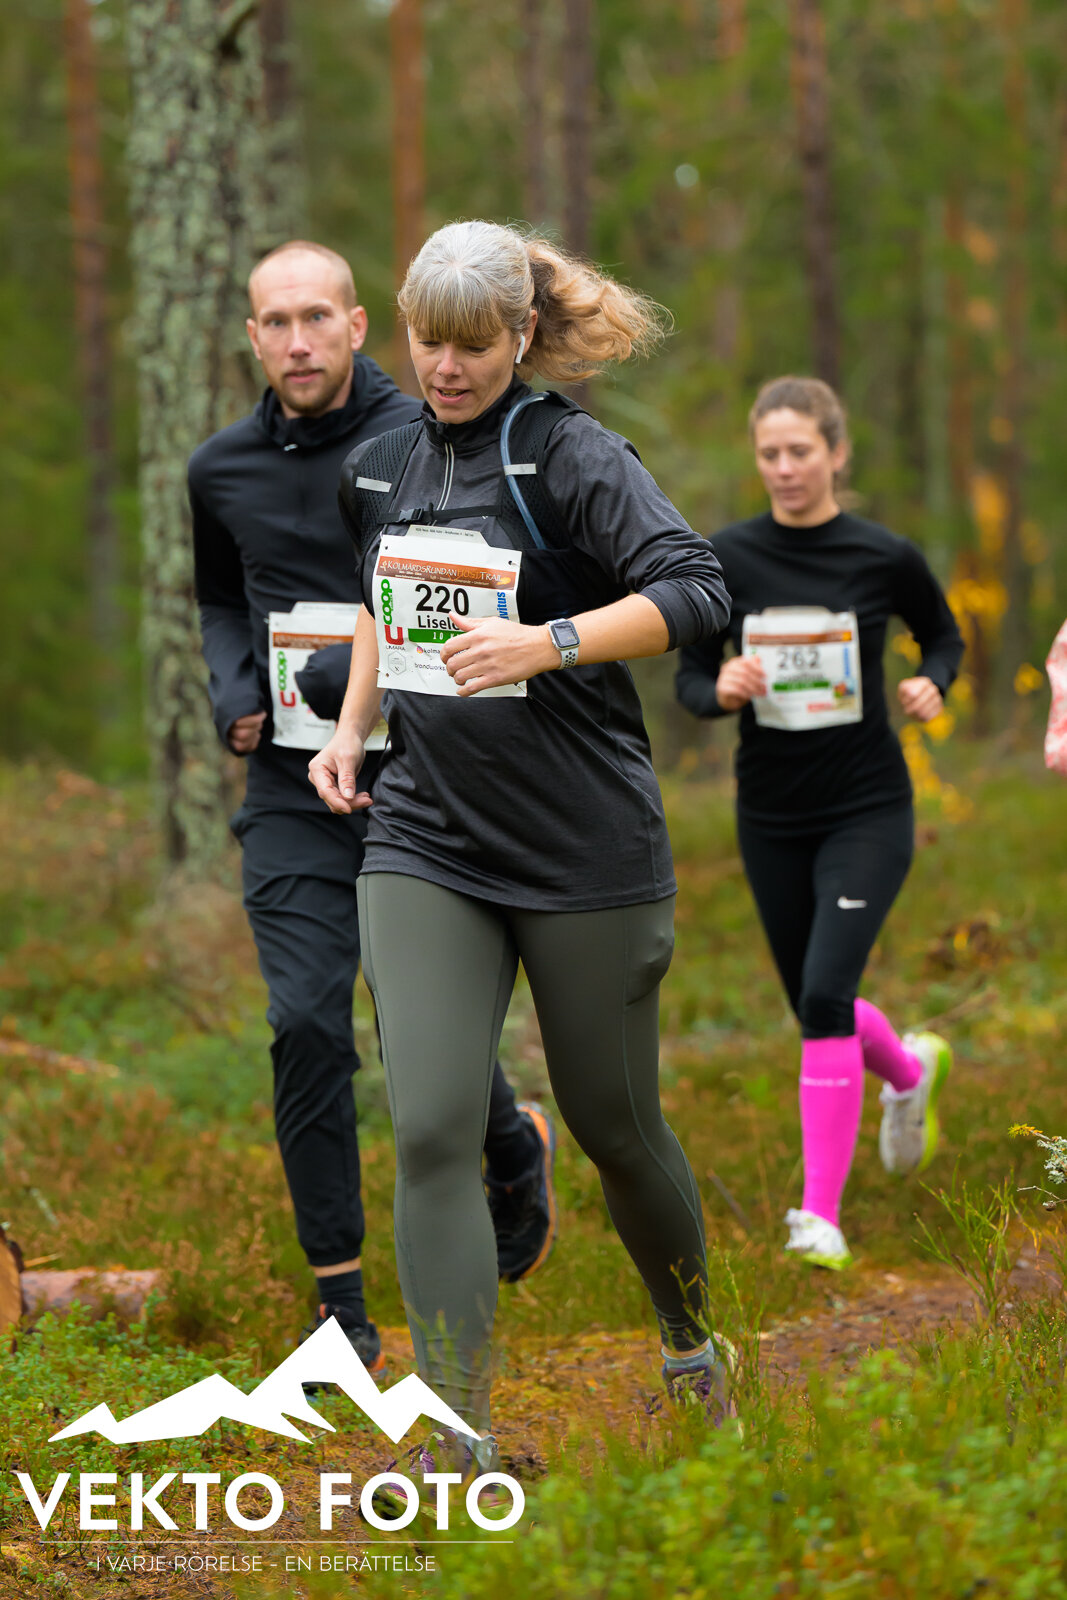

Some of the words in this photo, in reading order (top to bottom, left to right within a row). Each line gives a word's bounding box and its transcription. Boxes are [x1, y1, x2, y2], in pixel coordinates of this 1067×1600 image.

[381, 579, 393, 625] coop
[415, 583, 469, 616] 220
[433, 631, 444, 640] 10
[277, 651, 287, 691] coop
[777, 647, 821, 669] 262
